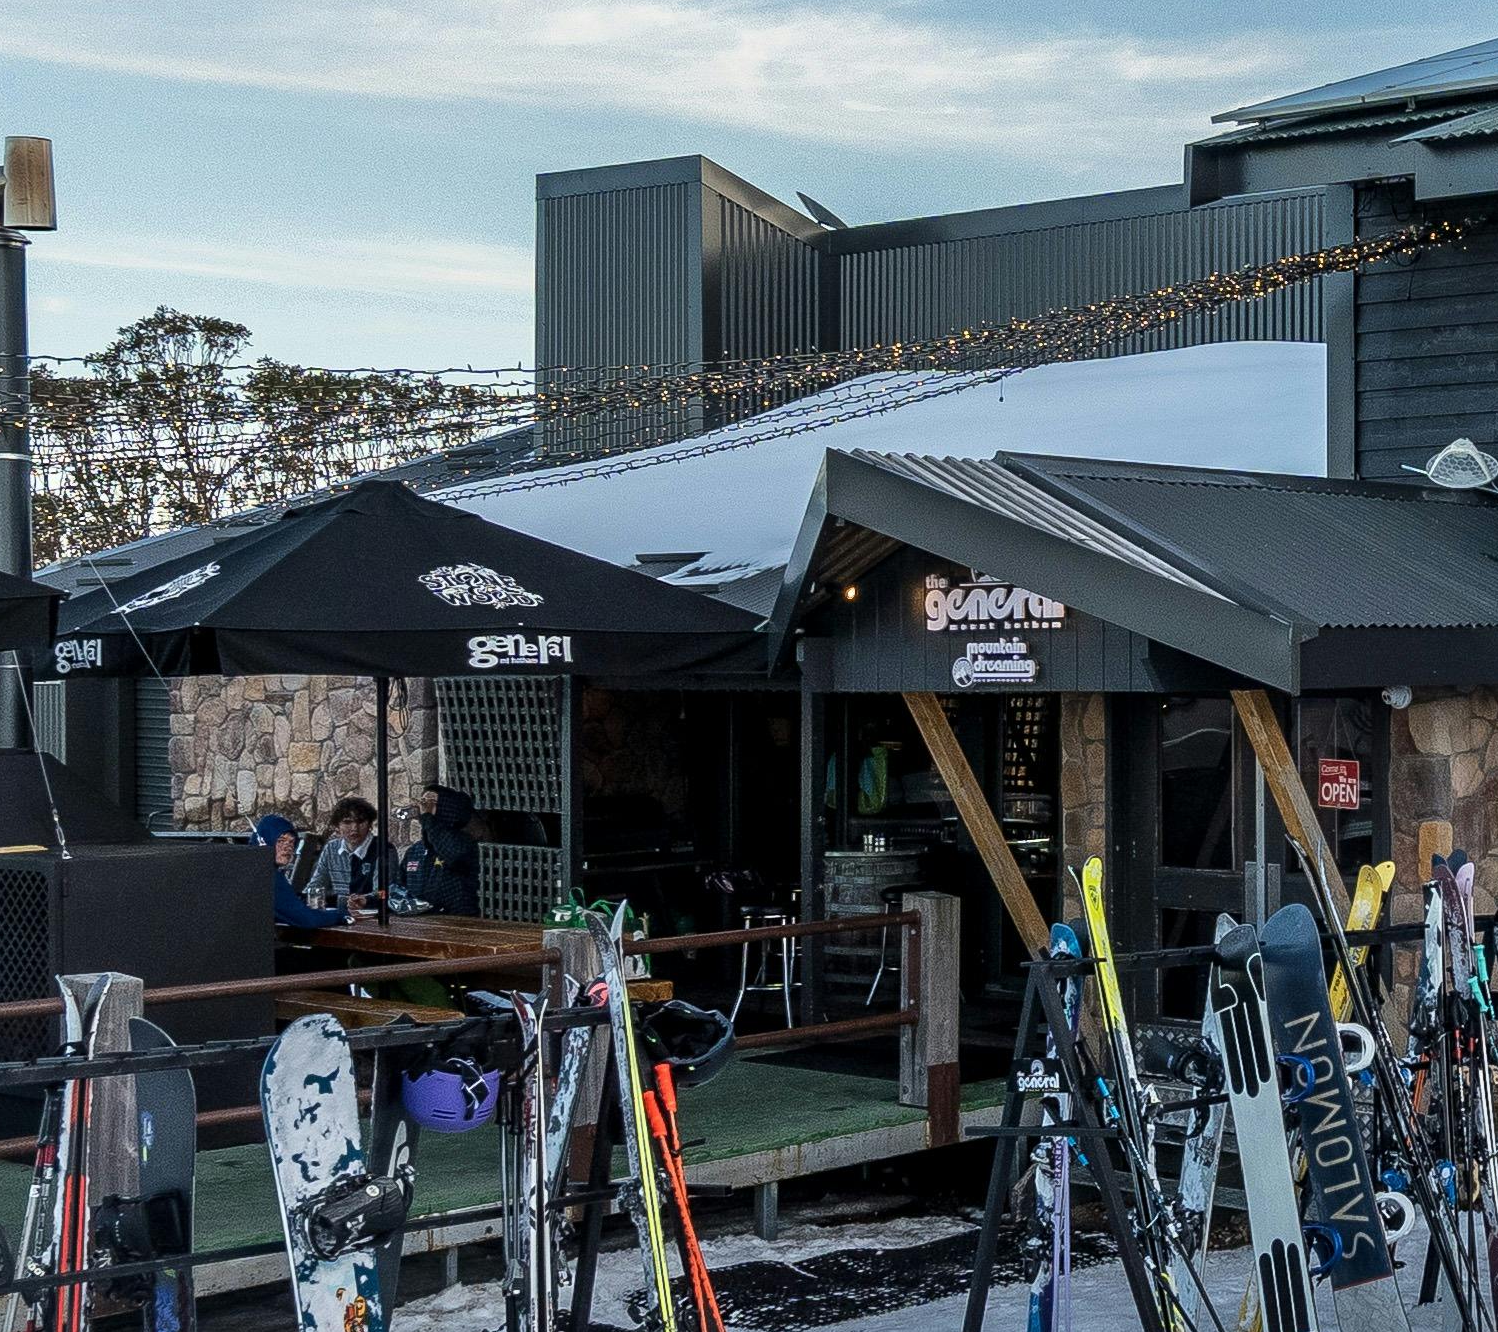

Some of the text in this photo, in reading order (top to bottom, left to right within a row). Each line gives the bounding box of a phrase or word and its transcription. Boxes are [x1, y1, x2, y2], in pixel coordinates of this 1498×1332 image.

[925, 574, 948, 589] the
[468, 633, 574, 668] general
[967, 636, 1028, 656] mountain
[973, 654, 1036, 677] dreaming
[1321, 782, 1357, 804] OPEN
[1018, 1071, 1060, 1092] general
[1284, 1010, 1376, 1261] SALOMON
